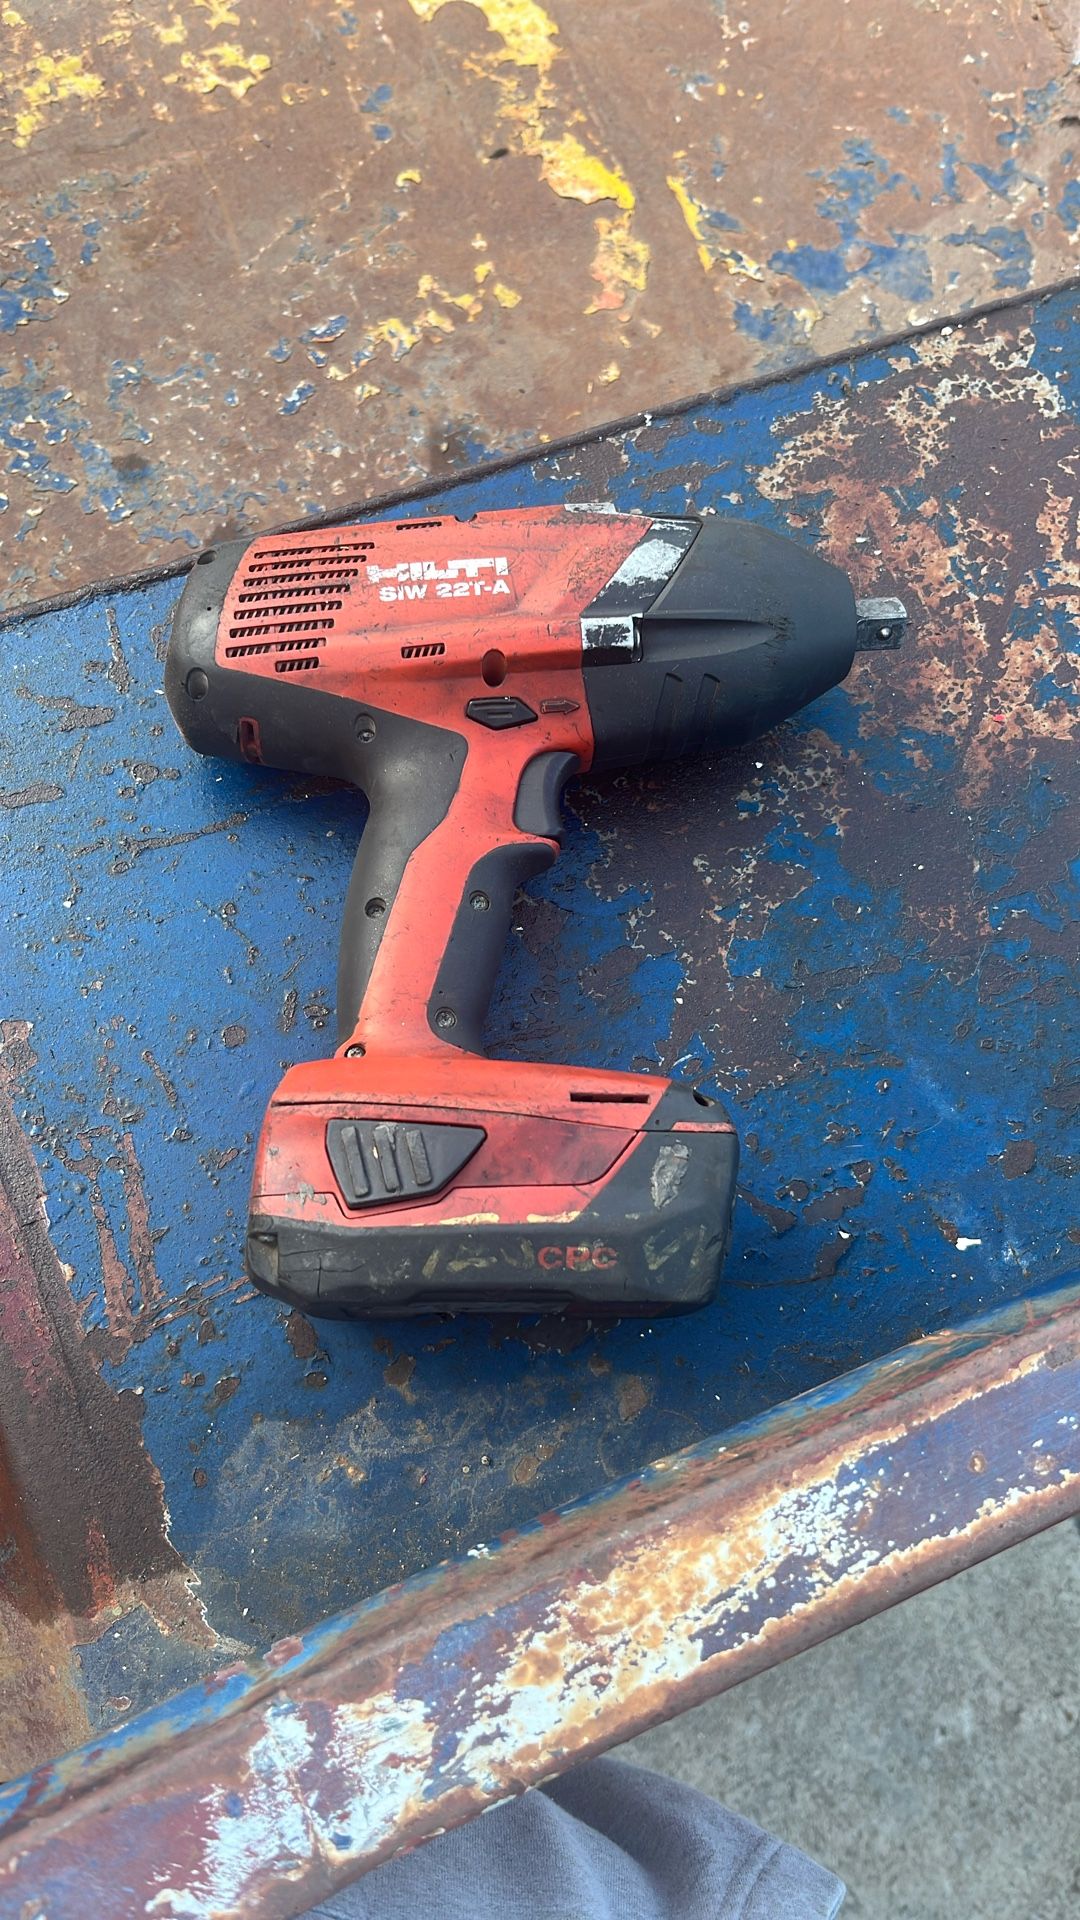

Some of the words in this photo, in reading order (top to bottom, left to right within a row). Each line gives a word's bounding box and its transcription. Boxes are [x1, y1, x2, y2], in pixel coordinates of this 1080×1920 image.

[366, 557, 509, 583] HILTI
[379, 584, 427, 602] SIW
[435, 579, 510, 598] 22T-A
[537, 1245, 618, 1270] CPC
